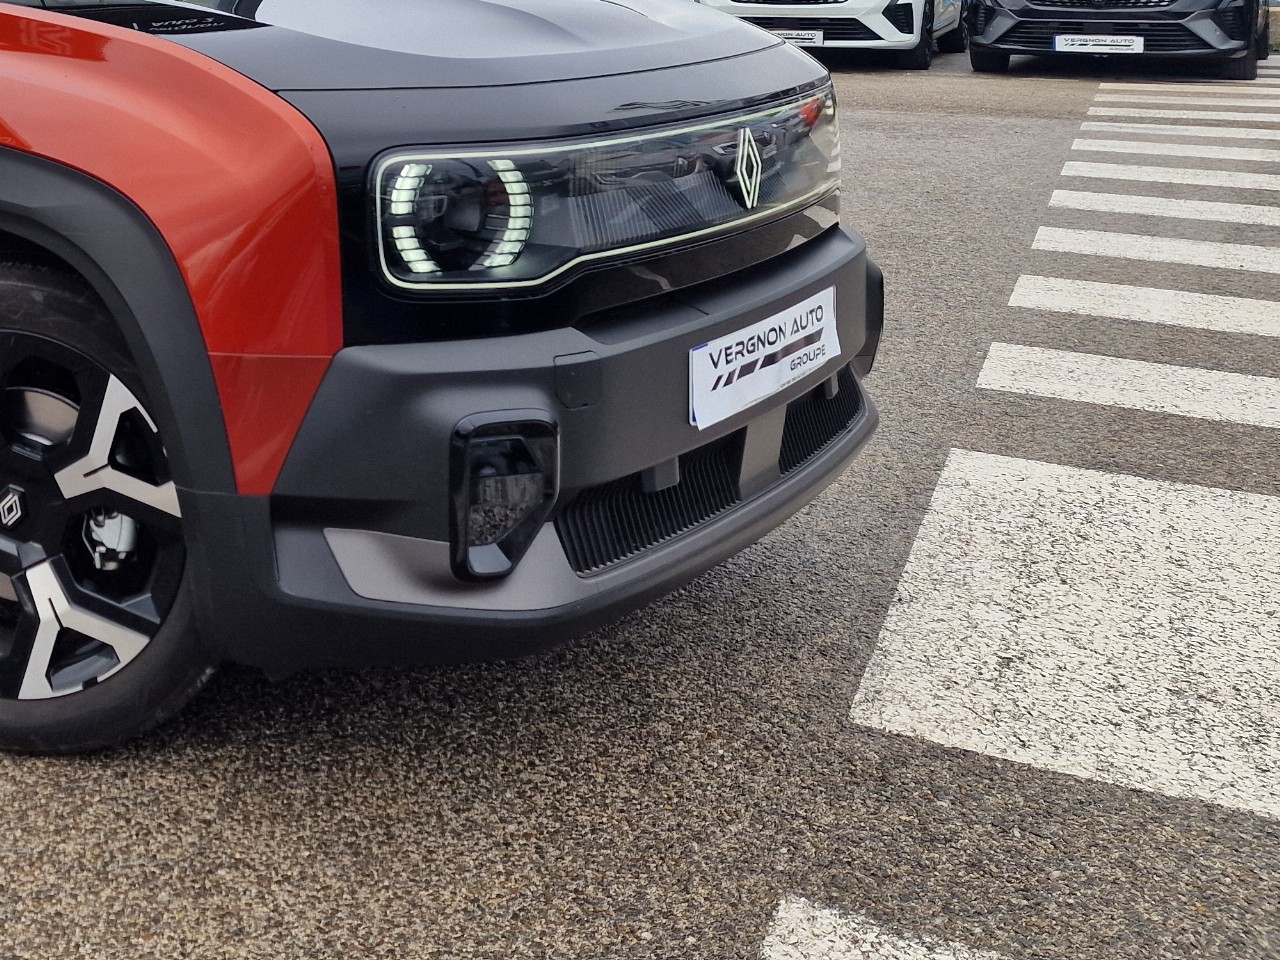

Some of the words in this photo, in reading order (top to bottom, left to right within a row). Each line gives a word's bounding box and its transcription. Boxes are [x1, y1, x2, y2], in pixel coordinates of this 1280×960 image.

[708, 322, 787, 370] VERGNON
[790, 304, 824, 336] AUTO
[790, 344, 826, 371] GROUPE
